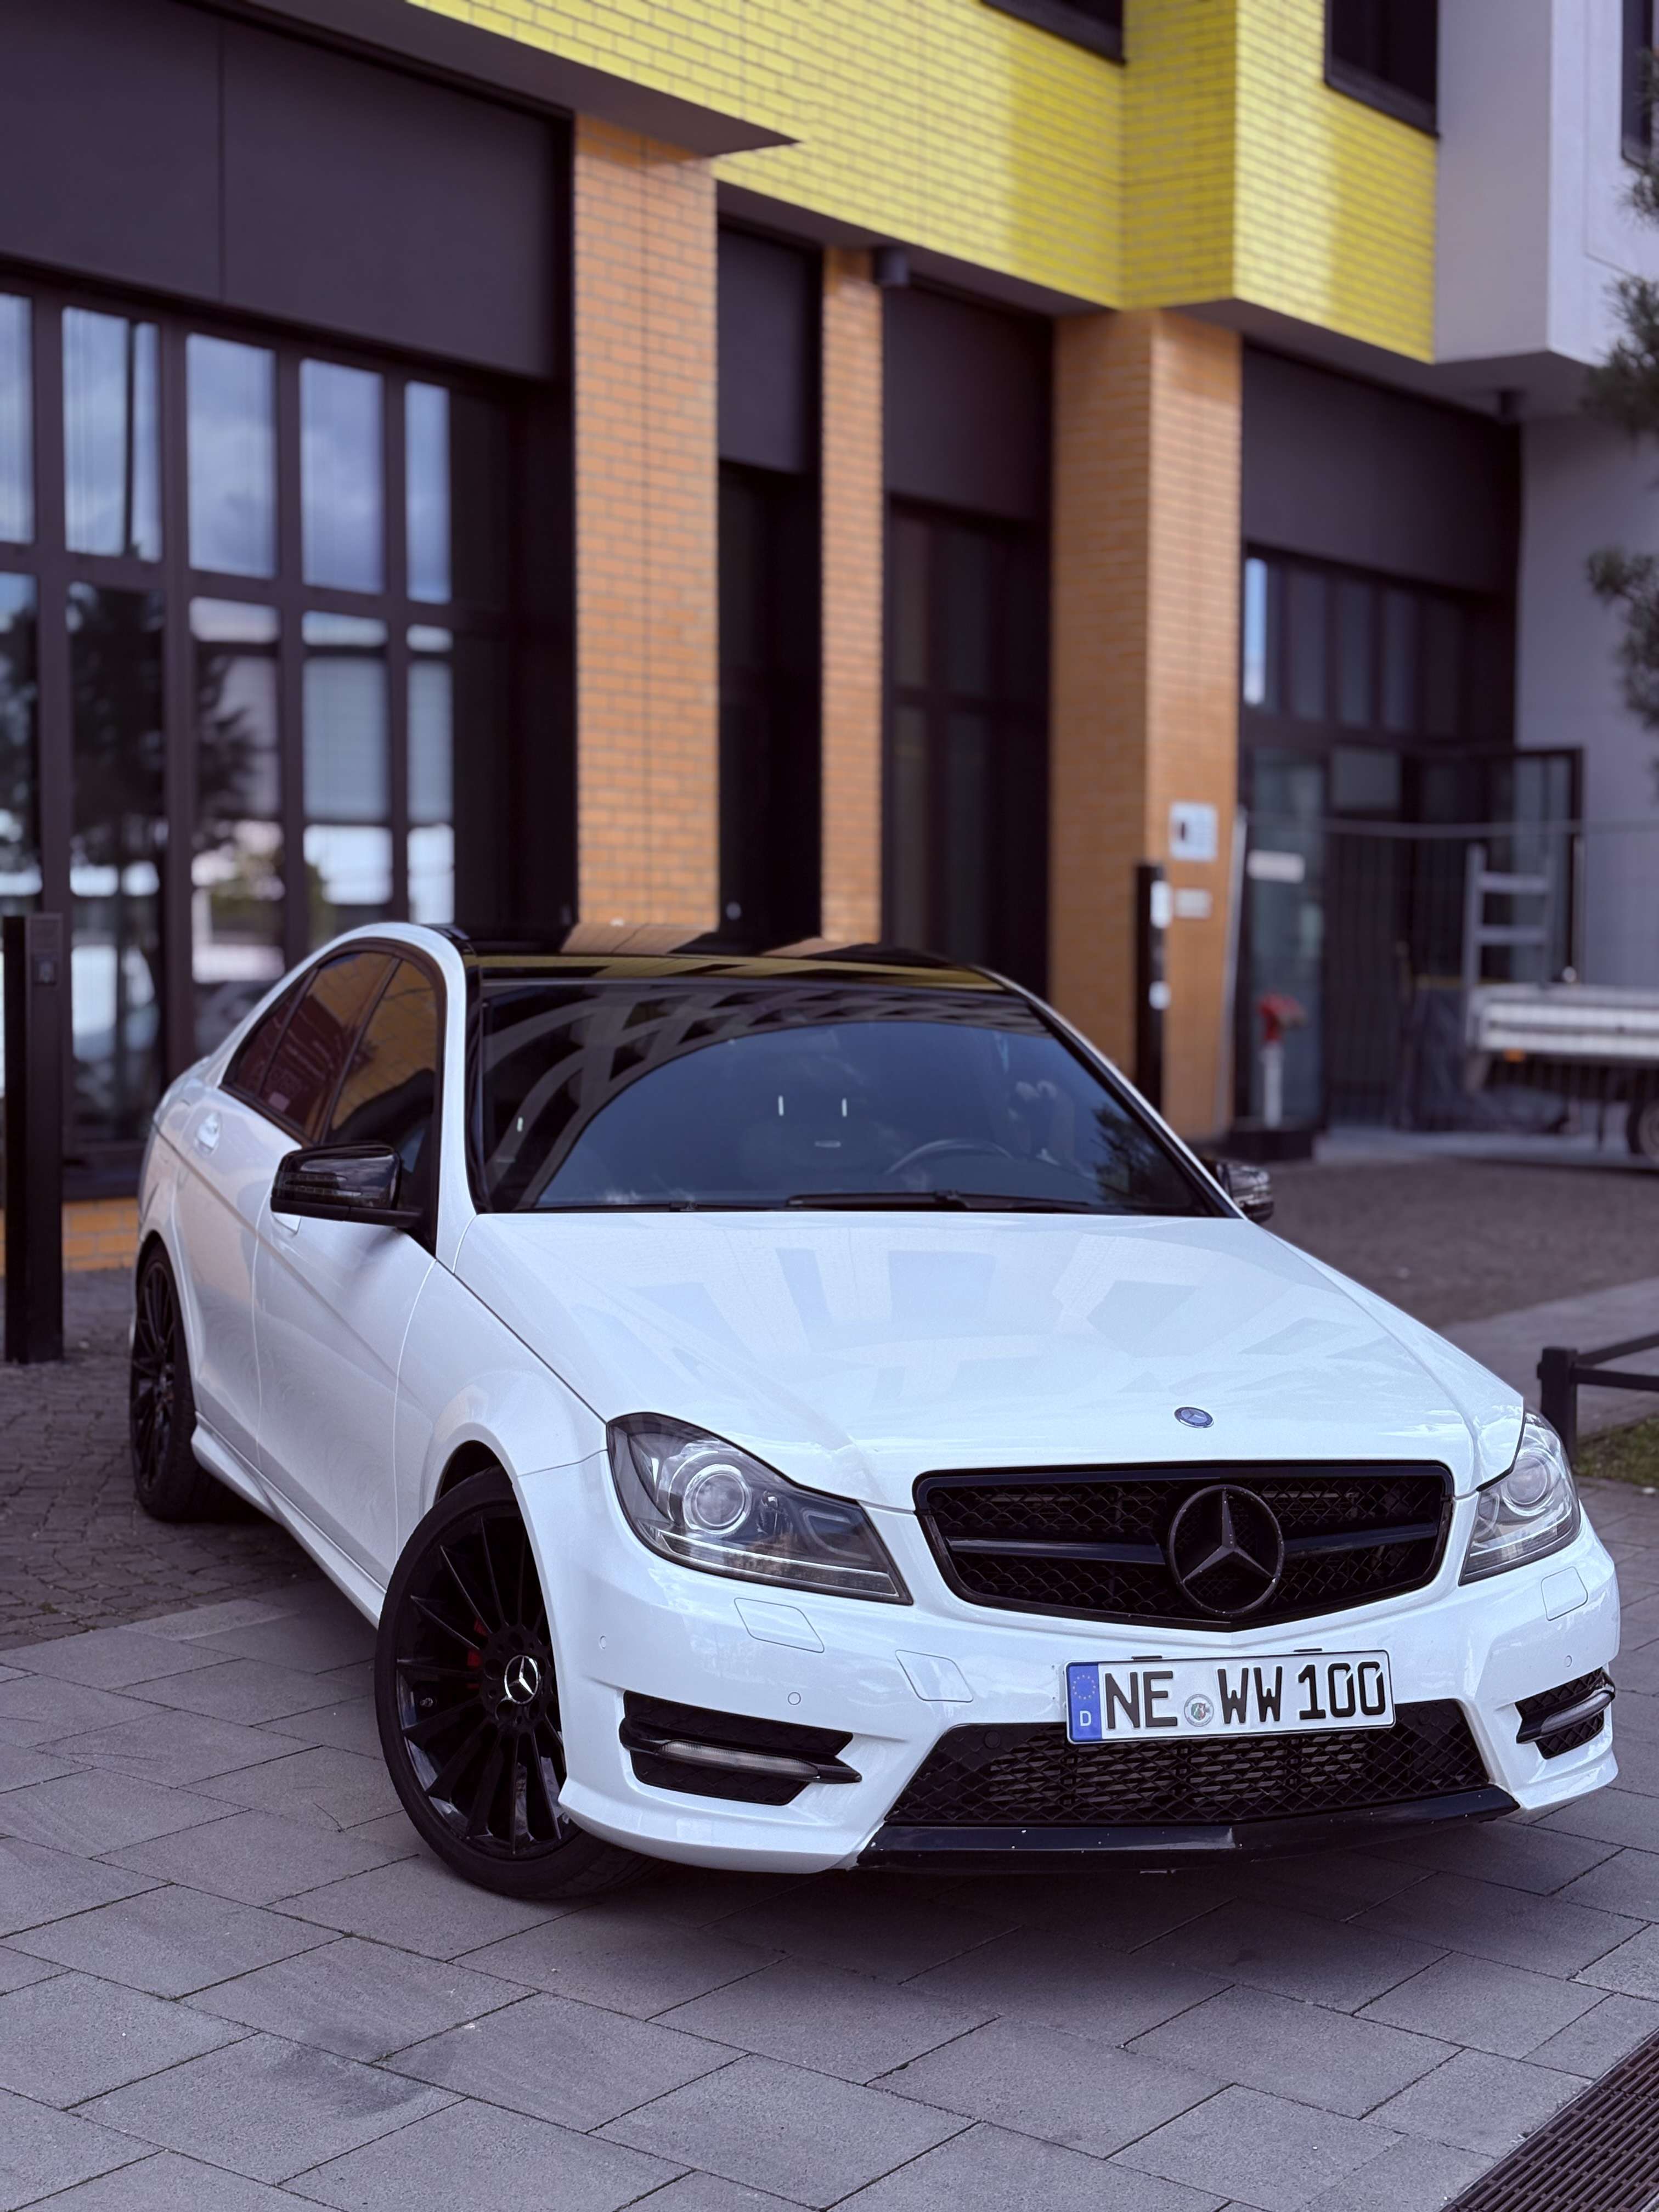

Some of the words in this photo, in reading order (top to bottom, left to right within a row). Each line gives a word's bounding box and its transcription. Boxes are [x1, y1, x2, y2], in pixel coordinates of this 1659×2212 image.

[1105, 1671, 1178, 1729] NE
[1217, 1666, 1283, 1724] WW
[1298, 1661, 1386, 1720] 100
[1080, 1710, 1092, 1726] D
